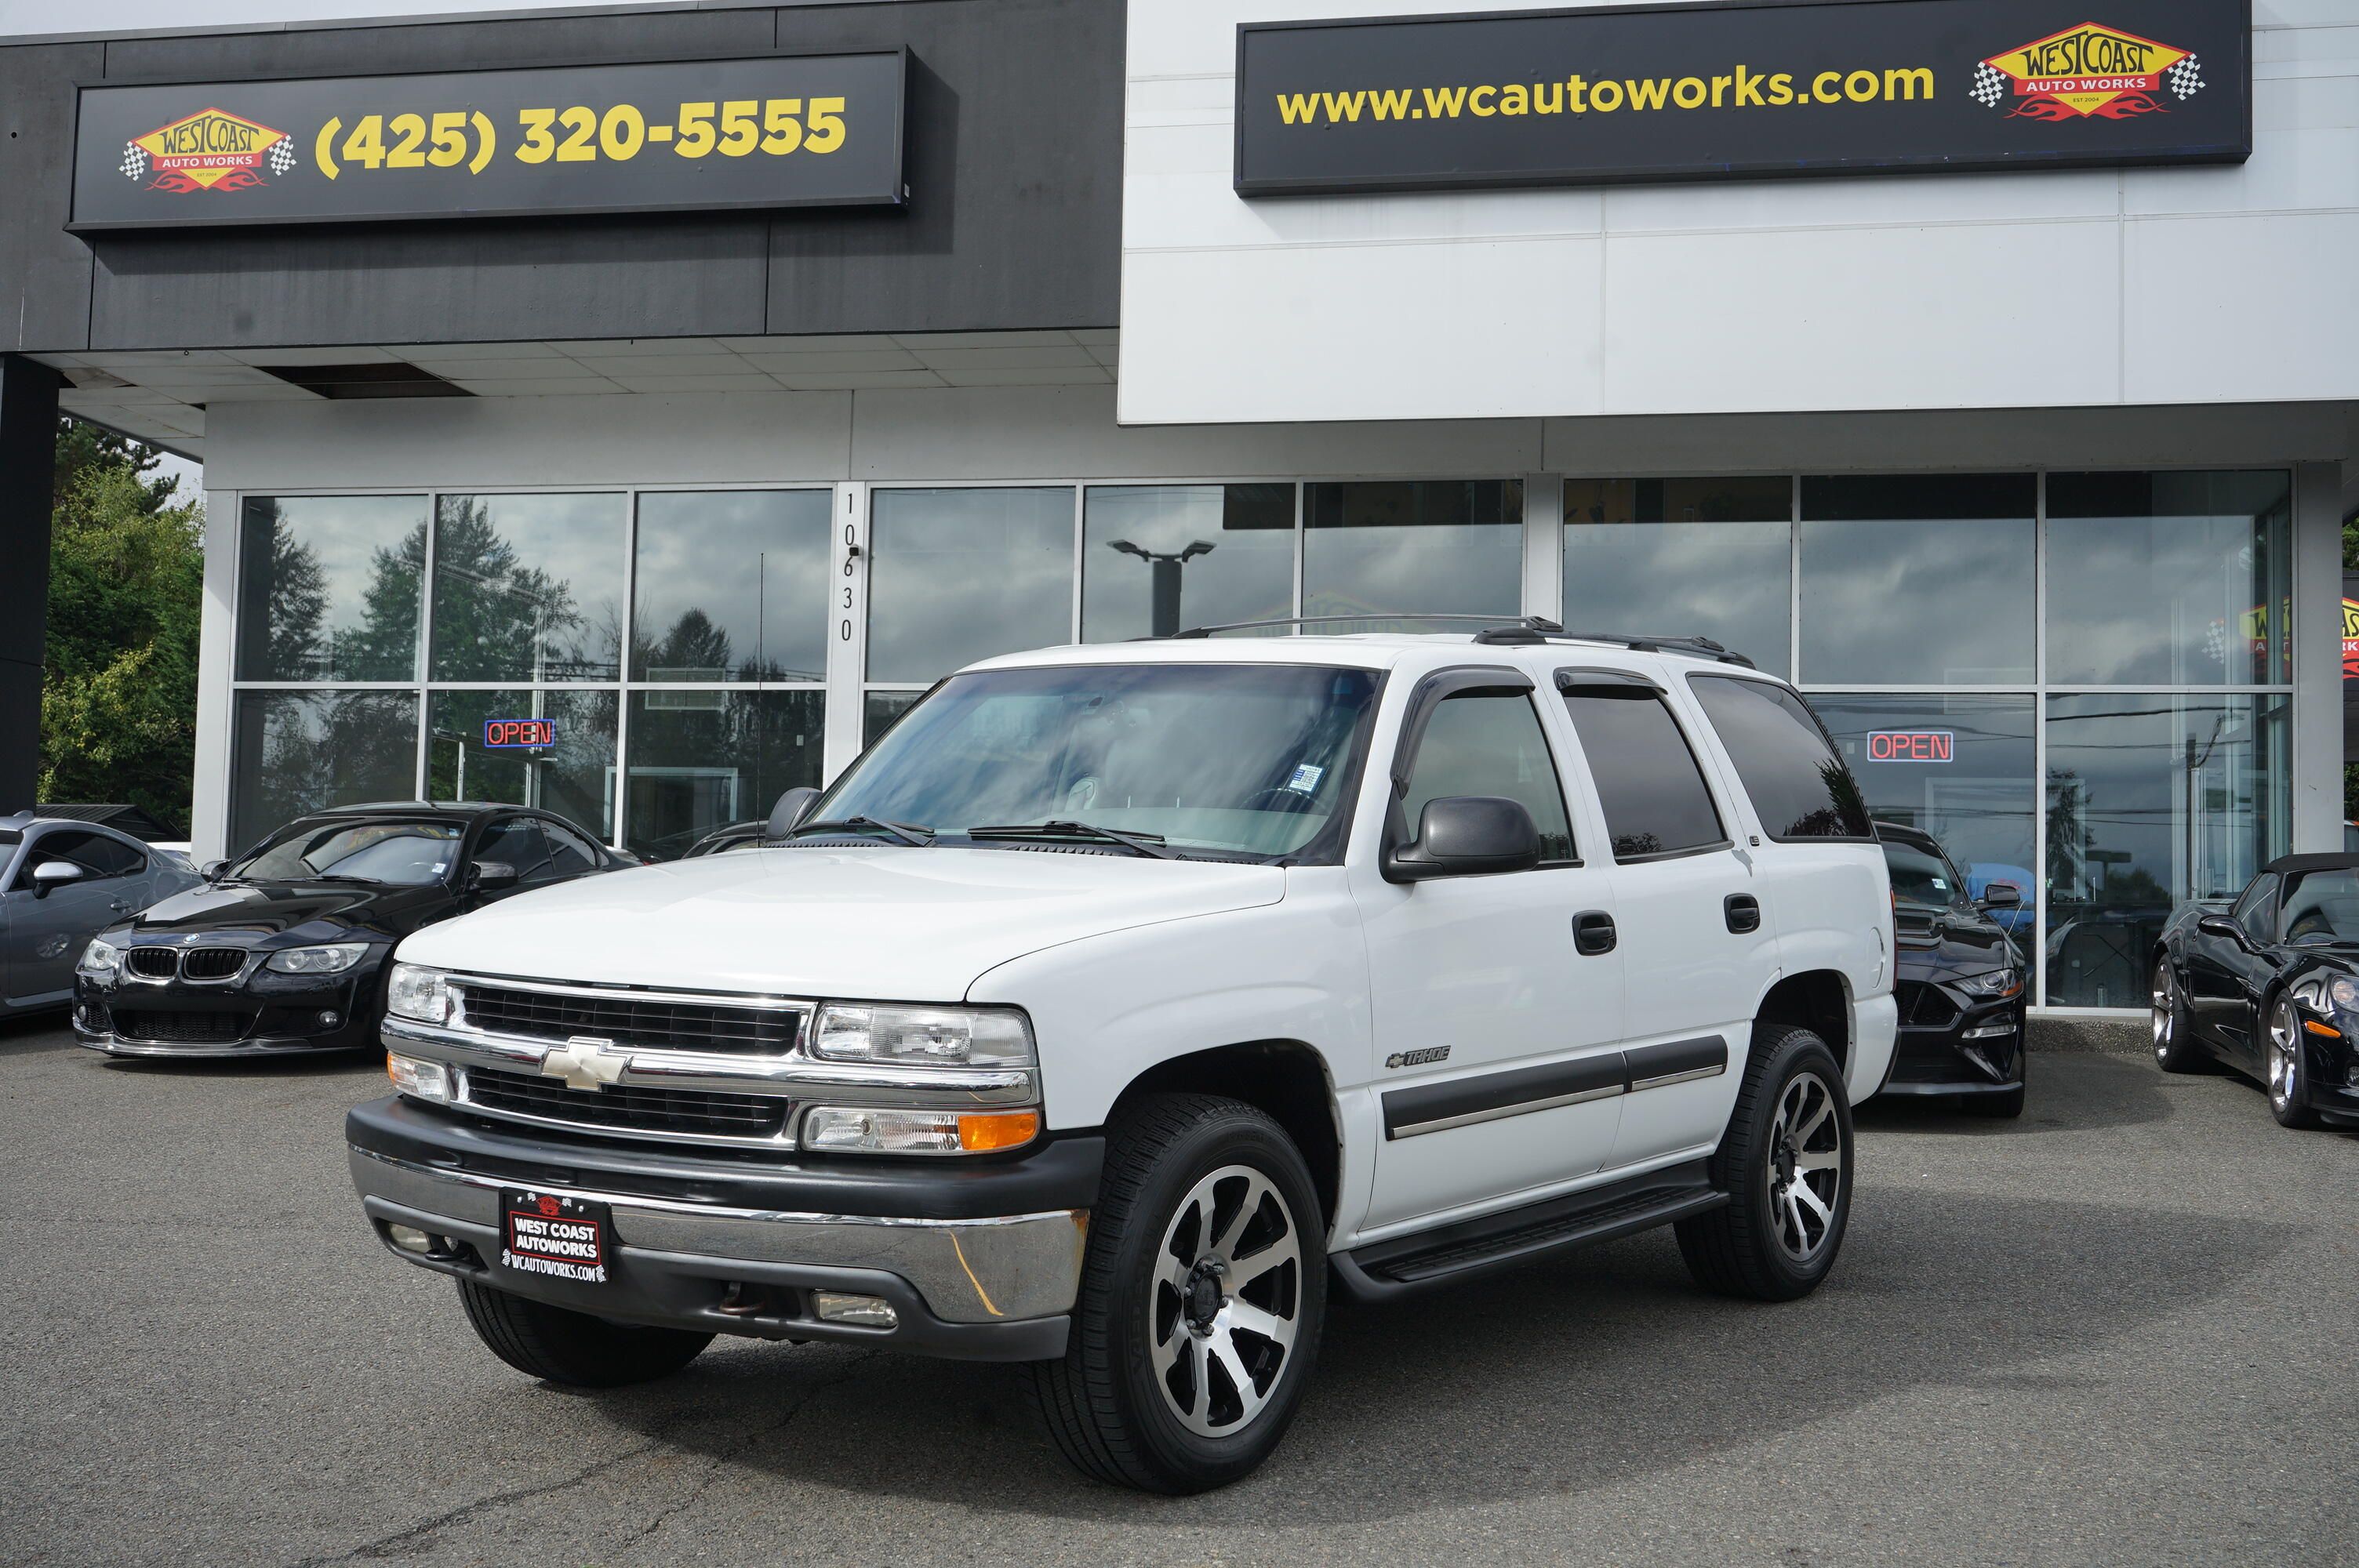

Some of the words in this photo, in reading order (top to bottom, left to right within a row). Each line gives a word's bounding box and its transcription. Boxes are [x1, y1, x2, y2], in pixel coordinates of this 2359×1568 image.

[1276, 64, 1935, 125] www.wcautoworks.com
[2026, 80, 2076, 92] AUTO
[2080, 78, 2146, 90] WORKS
[315, 110, 496, 181] (425)
[514, 96, 847, 165] 320-5555
[162, 158, 200, 168] AUTO
[203, 156, 253, 165] WORKS
[488, 722, 551, 744] OPEN
[1872, 734, 1949, 759] OPEN
[1405, 1046, 1451, 1065] TAHOE
[514, 1218, 547, 1235] WEST
[551, 1223, 594, 1241] COAST
[516, 1234, 598, 1258] AUTOWORKS
[511, 1254, 596, 1282] WCAUTOWORKS.COM
